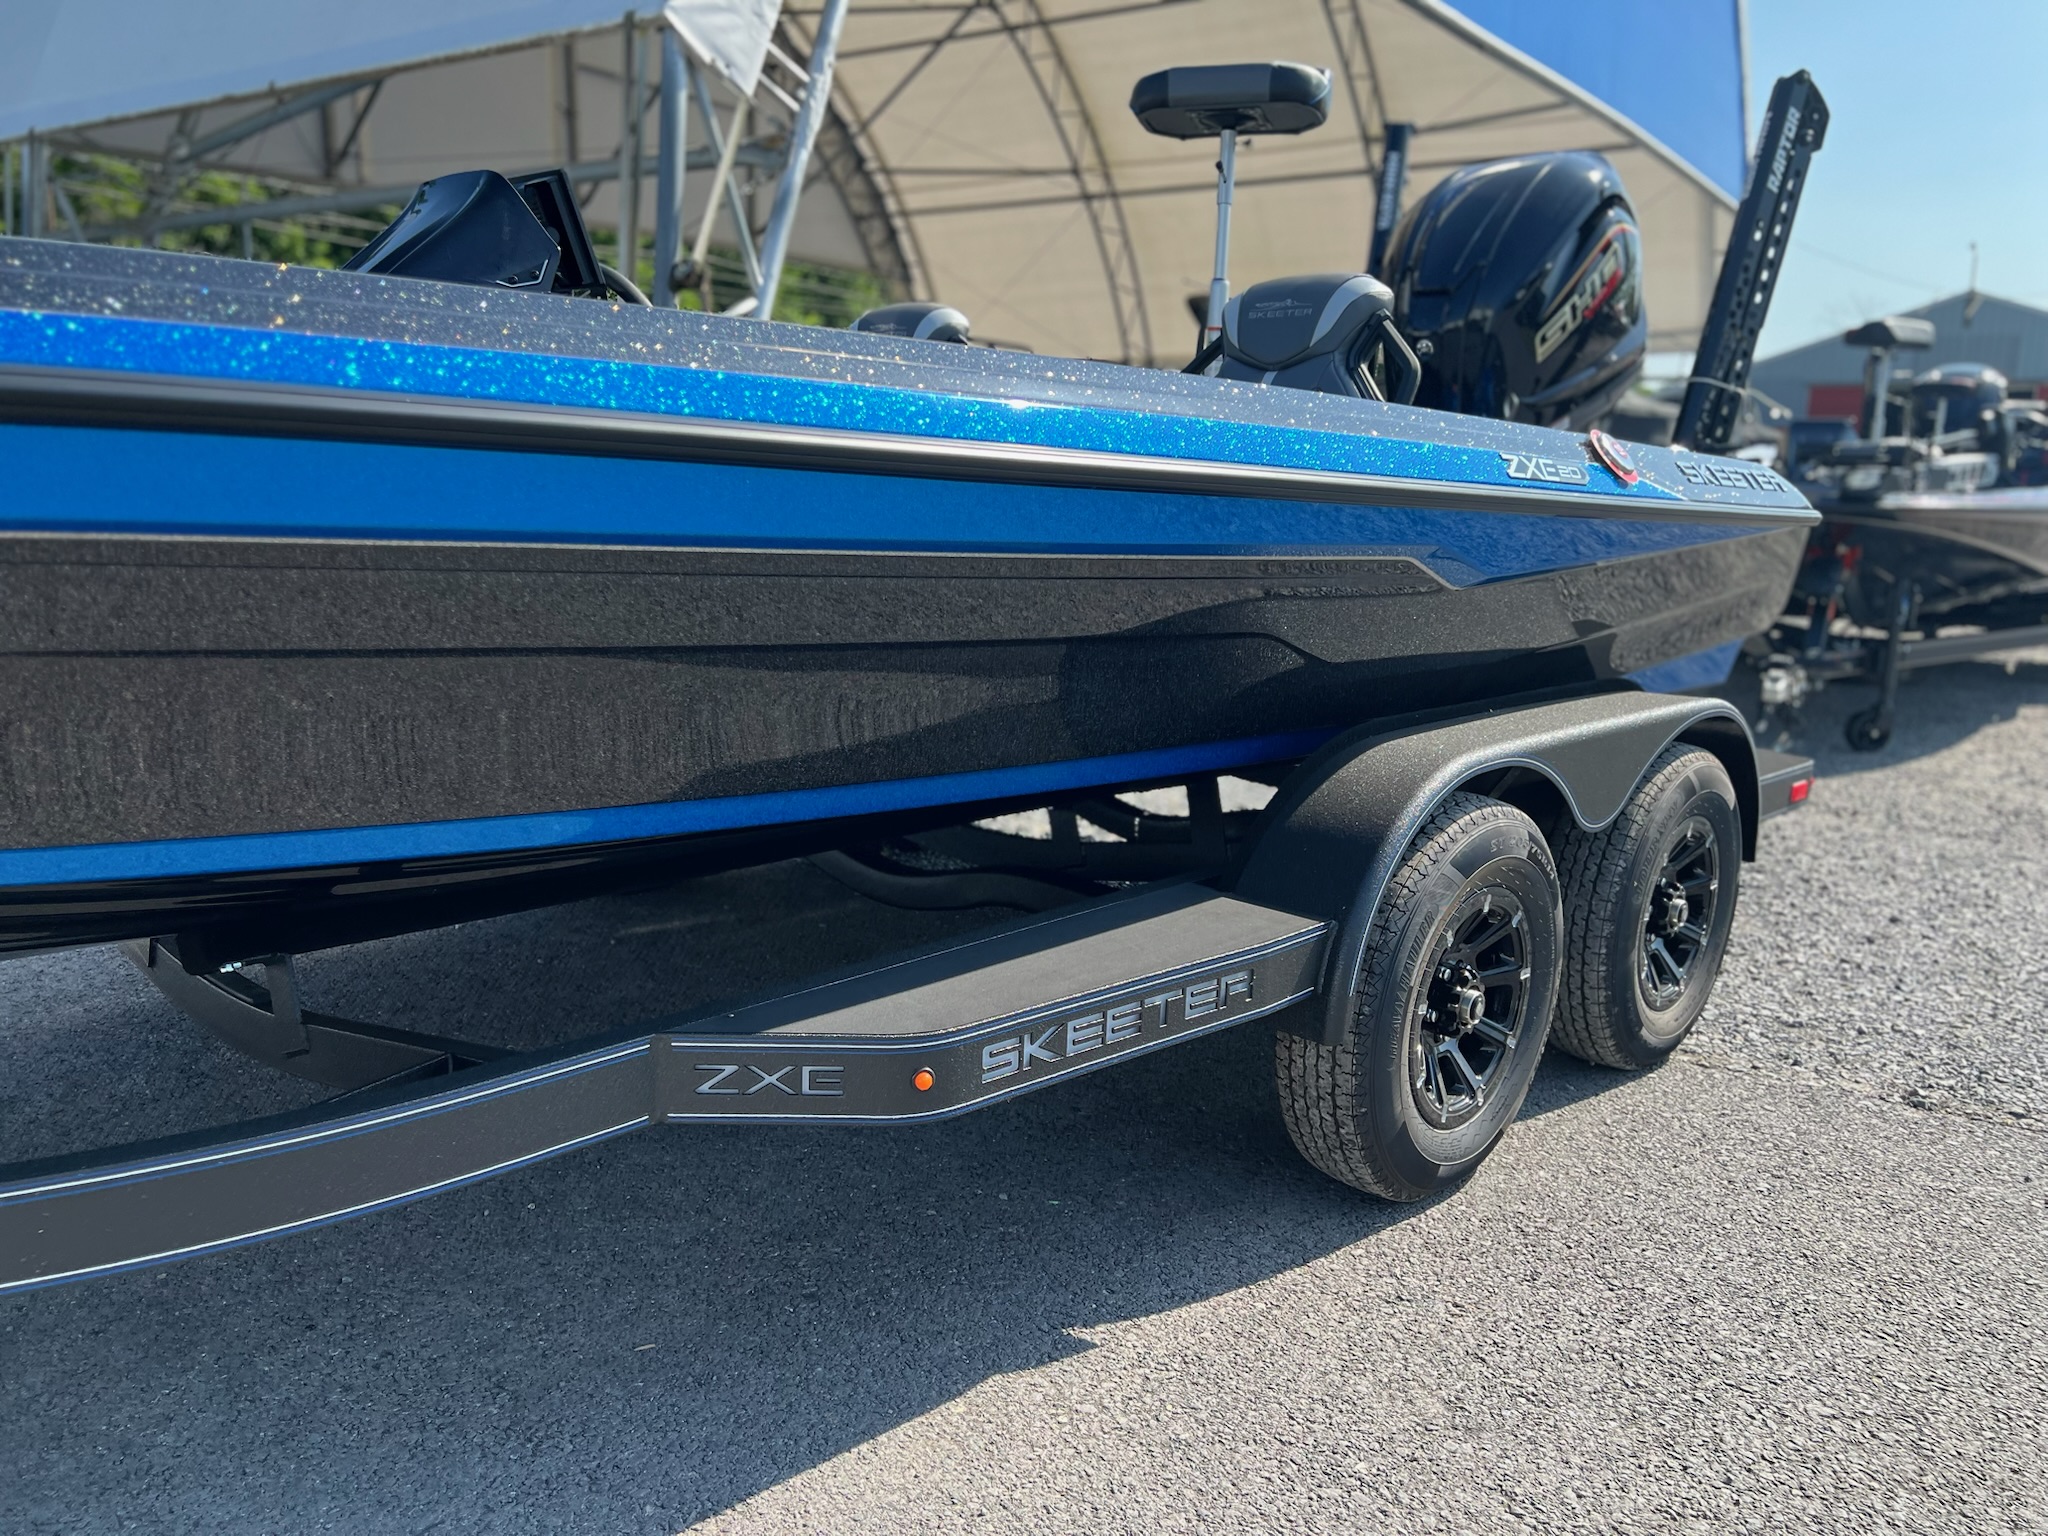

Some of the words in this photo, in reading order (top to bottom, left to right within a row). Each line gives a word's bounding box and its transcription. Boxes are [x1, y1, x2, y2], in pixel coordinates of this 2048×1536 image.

[1766, 106, 1801, 194] RAPTOR
[1248, 308, 1313, 319] SKEETER
[1675, 460, 1788, 492] SKEETER
[981, 968, 1255, 1083] SKEETER
[693, 1064, 845, 1096] ZXE
